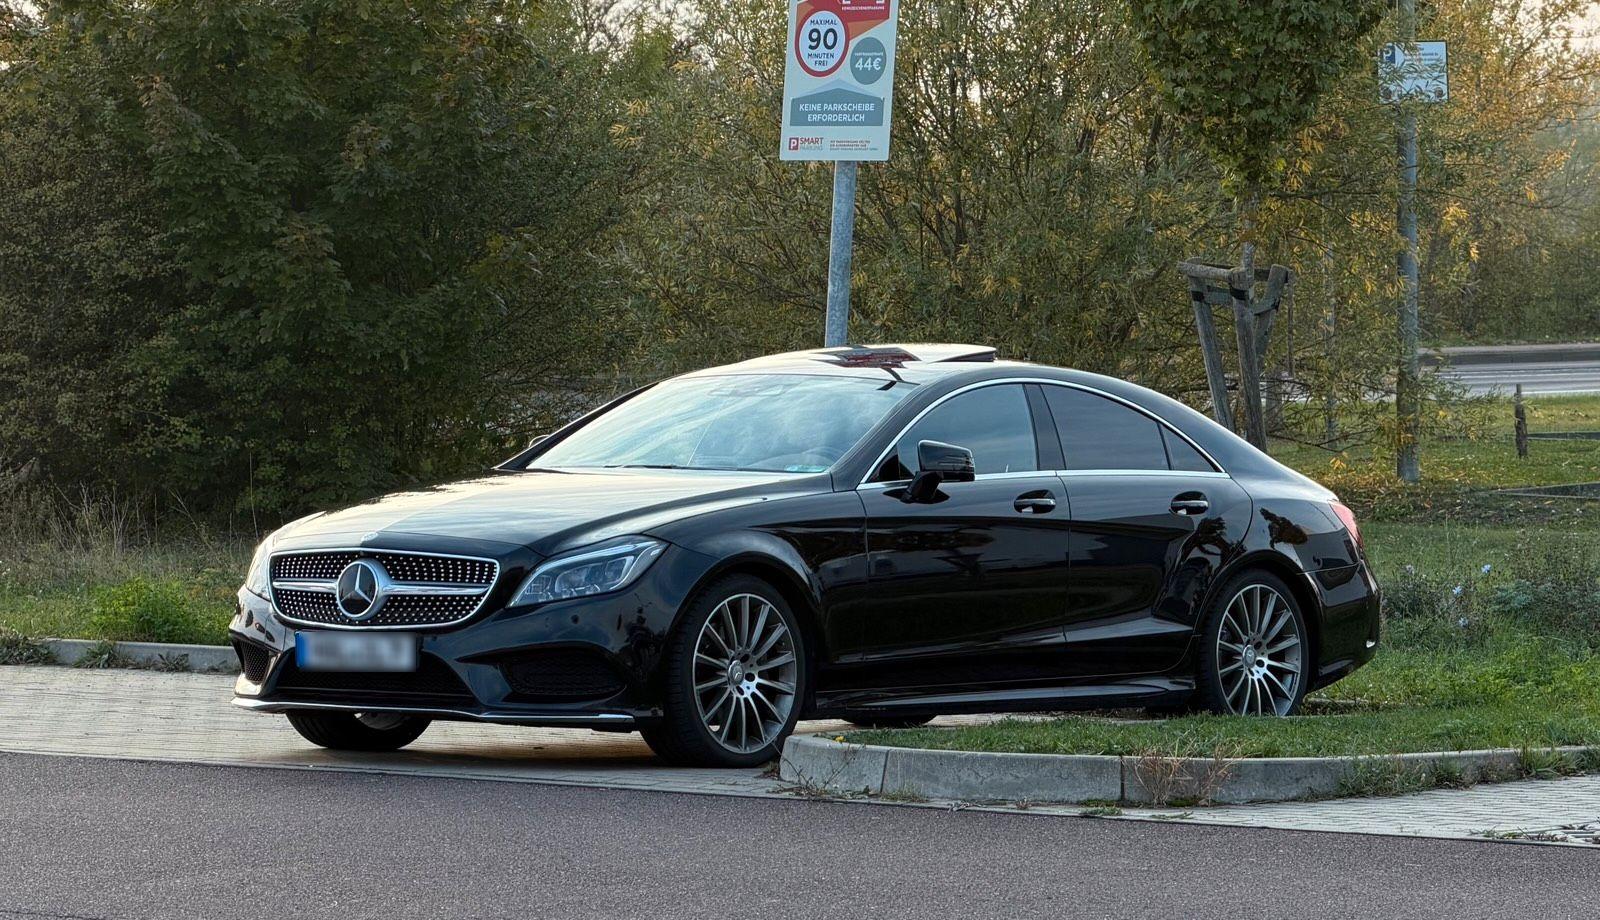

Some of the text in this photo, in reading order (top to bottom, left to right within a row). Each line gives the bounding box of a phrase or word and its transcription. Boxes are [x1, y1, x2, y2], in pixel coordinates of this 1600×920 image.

[808, 28, 838, 50] 90
[855, 57, 882, 71] 44€
[799, 103, 875, 112] KEINE PARKSCHEIBE
[807, 114, 865, 122] ERFORDERLICH
[799, 137, 824, 145] SMART
